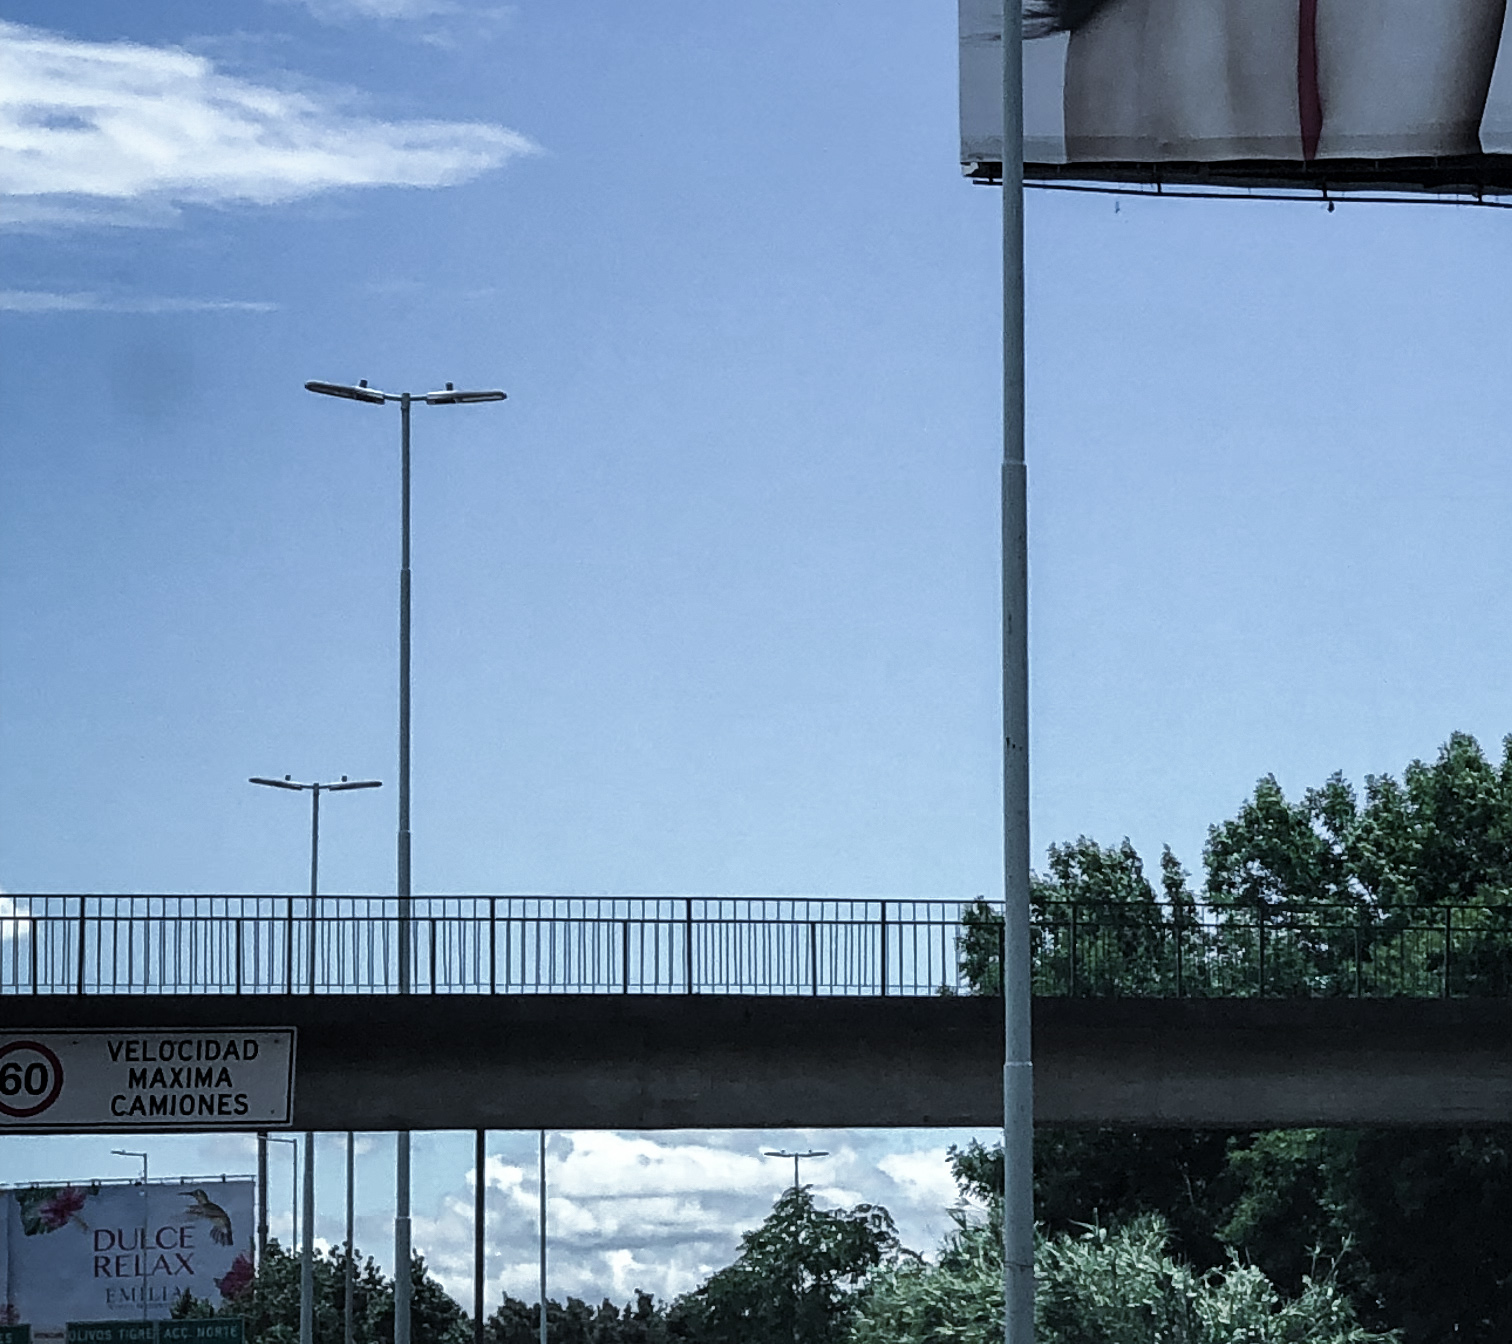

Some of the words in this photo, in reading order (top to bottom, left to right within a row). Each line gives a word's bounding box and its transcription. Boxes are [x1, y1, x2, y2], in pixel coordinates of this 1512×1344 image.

[107, 1039, 259, 1062] VELOCIDAD
[0, 1062, 49, 1096] 60
[128, 1066, 233, 1089] MAXIMA
[110, 1093, 249, 1116] CAMIONES
[93, 1225, 196, 1252] DULCE
[93, 1252, 195, 1278] RELAX
[68, 1329, 112, 1342] OLIVOS
[119, 1327, 154, 1340] TIGRE
[196, 1325, 238, 1338] NORTE
